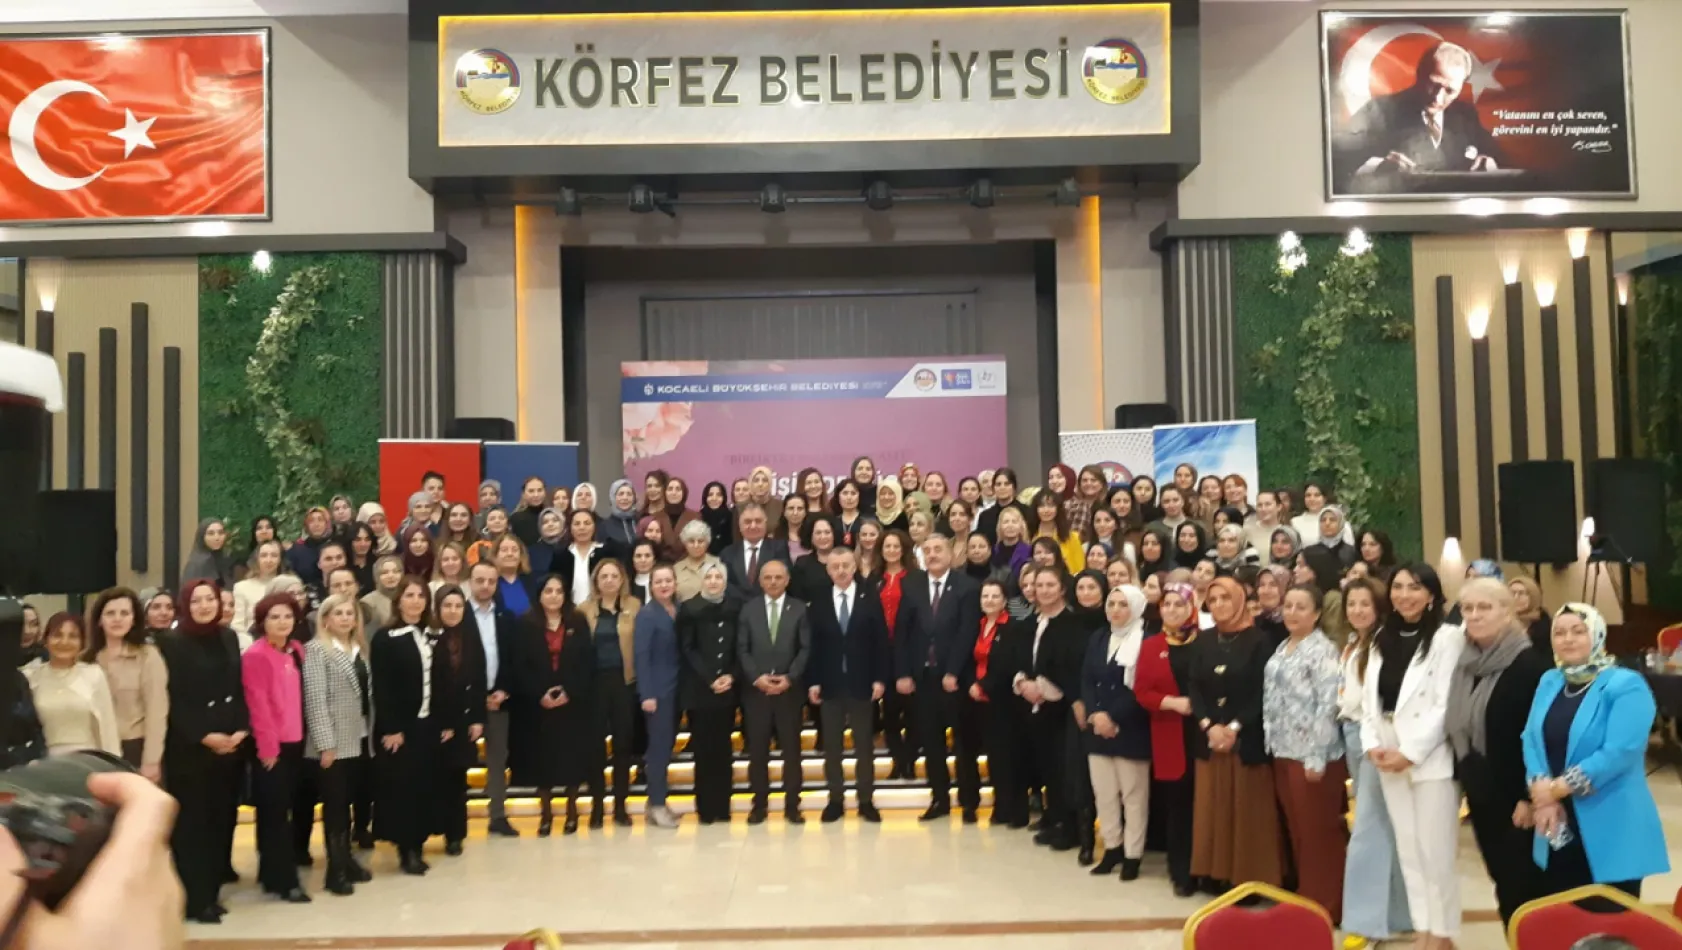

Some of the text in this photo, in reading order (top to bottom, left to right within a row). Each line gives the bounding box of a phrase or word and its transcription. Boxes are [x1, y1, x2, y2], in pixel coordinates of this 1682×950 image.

[535, 36, 1069, 108] KÖRFEZ BELEDİYESİ
[1542, 111, 1555, 120] en
[1557, 108, 1575, 121] çok
[1576, 110, 1607, 121] seven,
[1491, 123, 1533, 137] görevini
[1535, 126, 1548, 134] en
[1550, 123, 1563, 136] iyi
